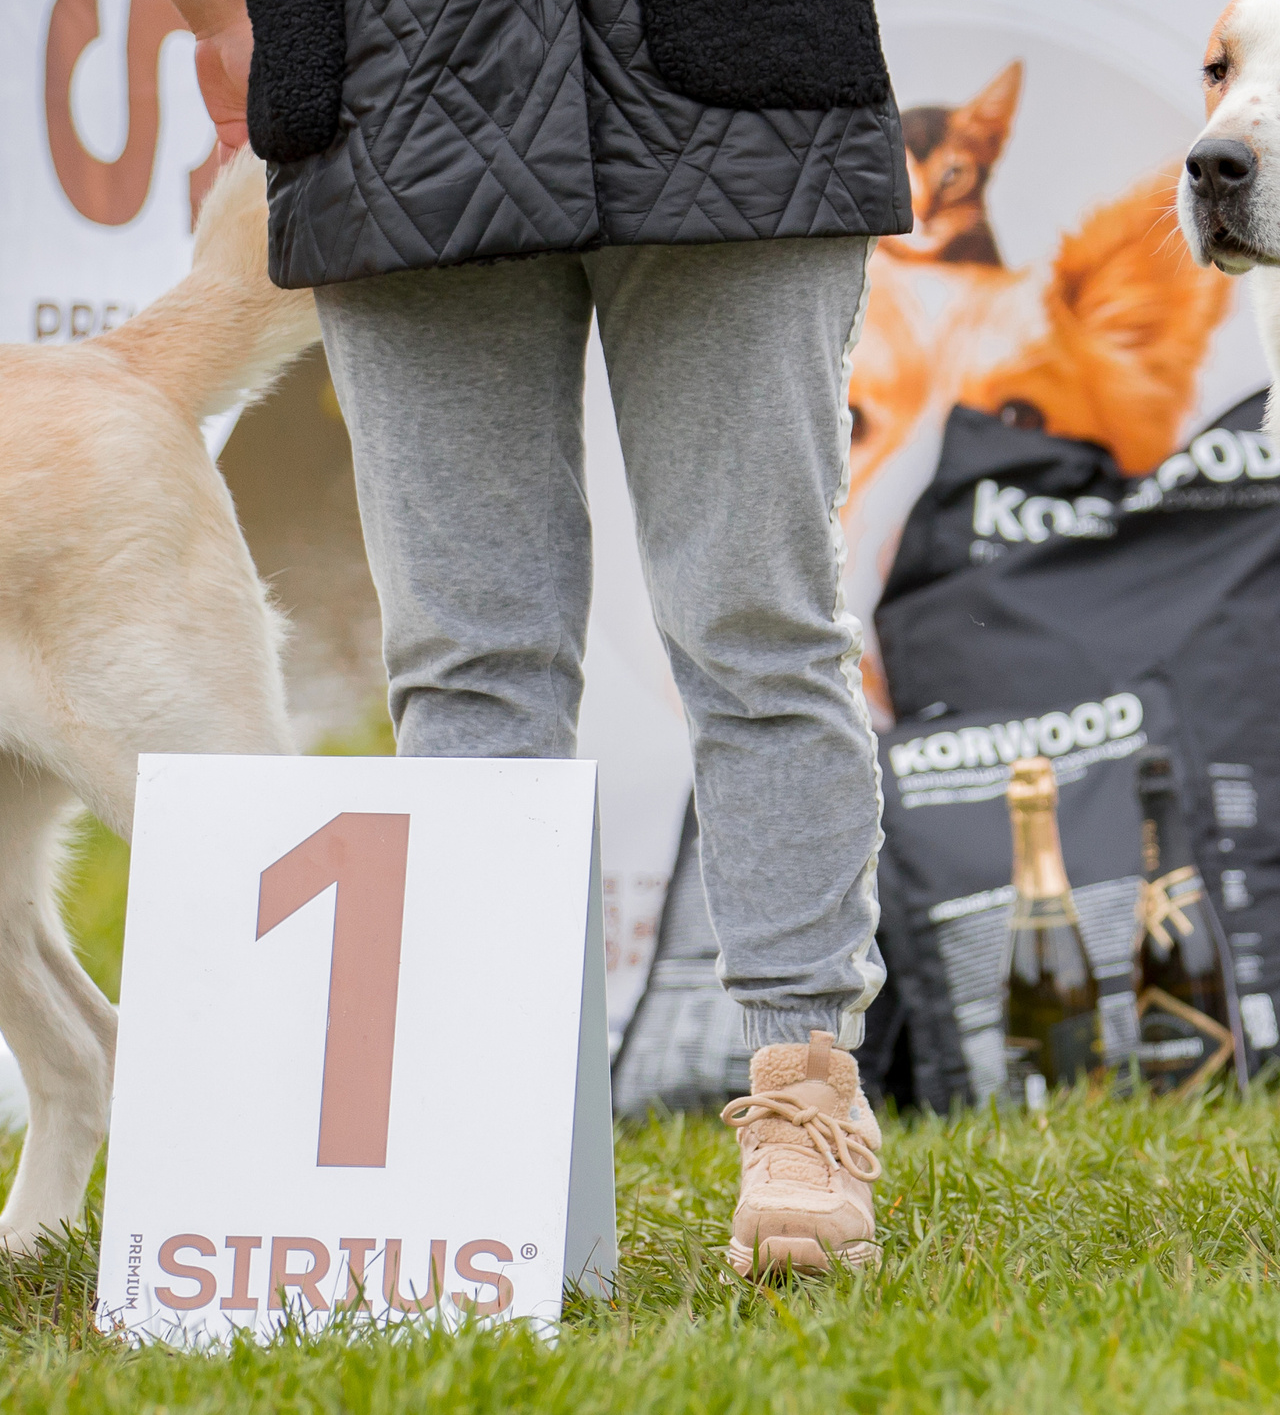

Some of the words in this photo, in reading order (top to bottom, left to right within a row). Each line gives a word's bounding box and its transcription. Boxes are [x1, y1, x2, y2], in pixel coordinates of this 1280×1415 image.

[889, 692, 1143, 777] KORWOOD
[256, 811, 411, 1169] 1
[126, 1234, 143, 1310] PREMIUM
[155, 1233, 515, 1315] SIRIUS
